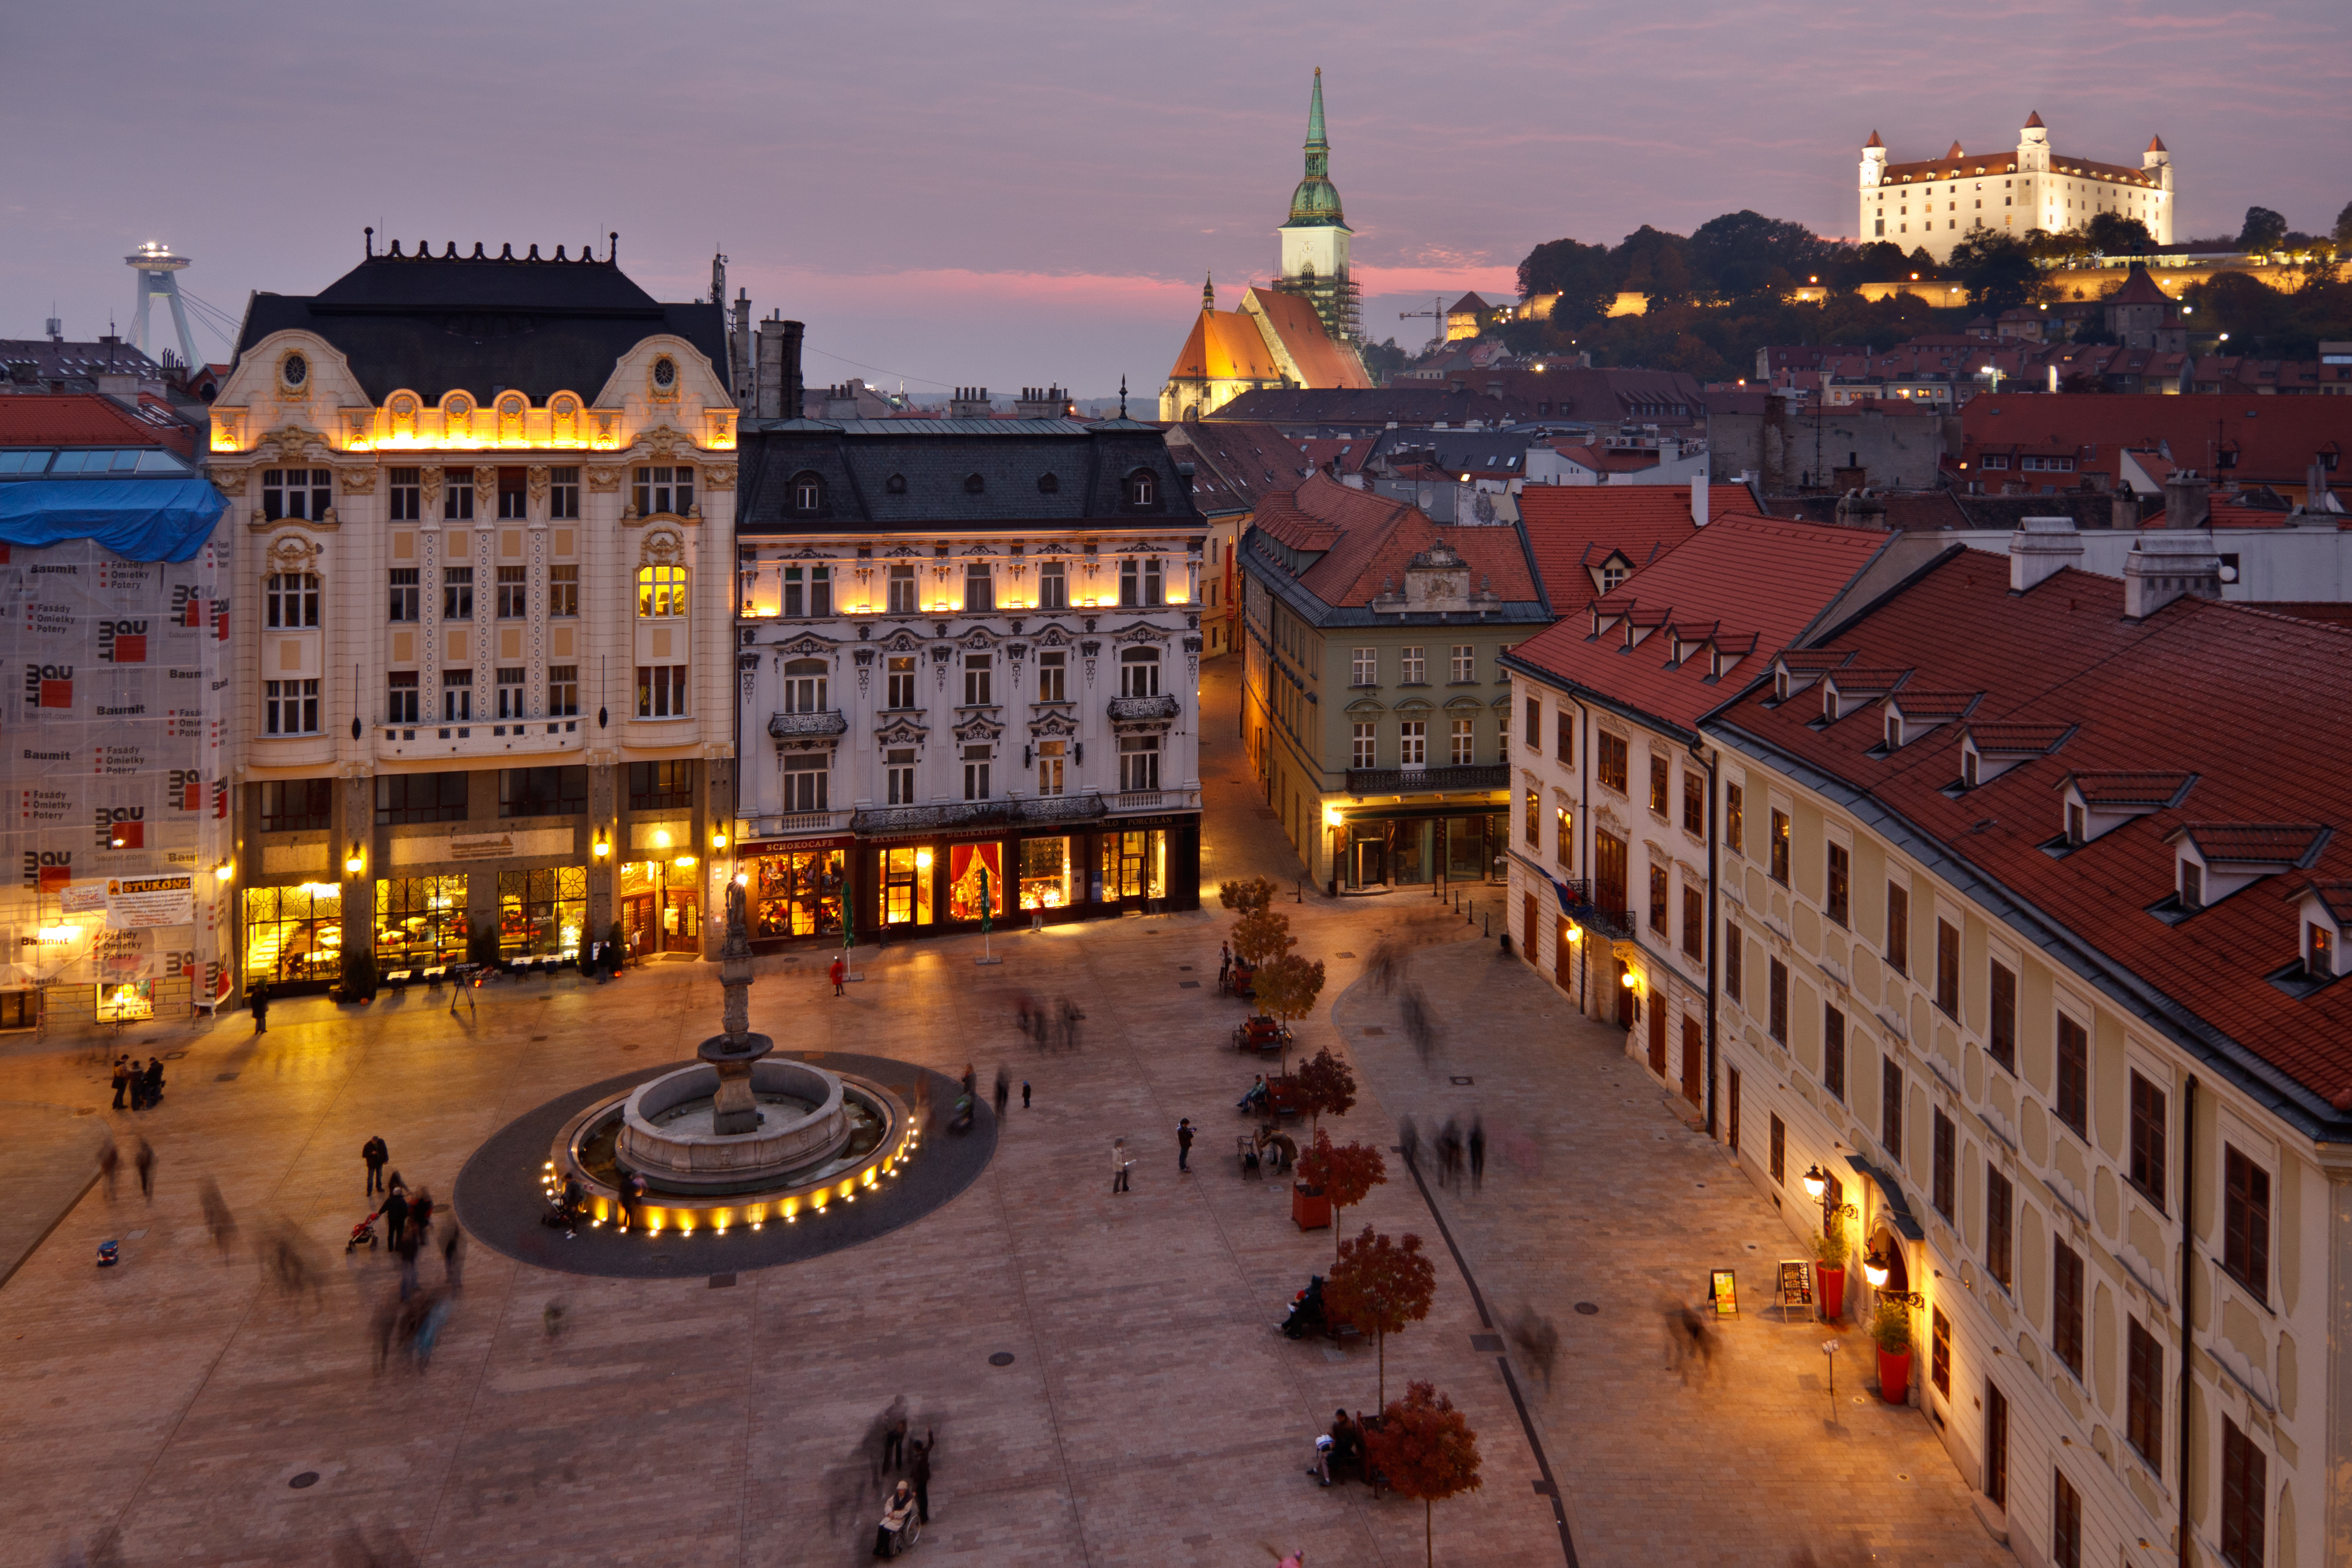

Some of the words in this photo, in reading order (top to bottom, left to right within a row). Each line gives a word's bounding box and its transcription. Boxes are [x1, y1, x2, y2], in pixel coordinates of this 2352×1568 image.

[31, 564, 77, 574] Baumit
[111, 571, 149, 579] Omietky
[111, 581, 141, 589] Potery
[38, 604, 70, 614] Fasády
[38, 614, 75, 624] Omietky
[37, 624, 67, 634] Potery
[97, 704, 145, 715] Baumit
[107, 746, 140, 754] Fasády
[24, 750, 71, 760] Baumit
[106, 756, 145, 764] Omietky
[34, 790, 66, 800] Fasády
[33, 801, 71, 810] Omietky
[33, 811, 63, 820] Potery
[1096, 819, 1119, 828] SKLO
[1128, 816, 1172, 825] PORCELÁN
[870, 833, 933, 844] MAXIMILIAN
[766, 839, 835, 851] SCHOKOCAFE
[105, 931, 138, 939] Fasády
[21, 937, 69, 945] Baumit
[103, 941, 142, 950] Omietky
[30, 977, 62, 986] Fasády
